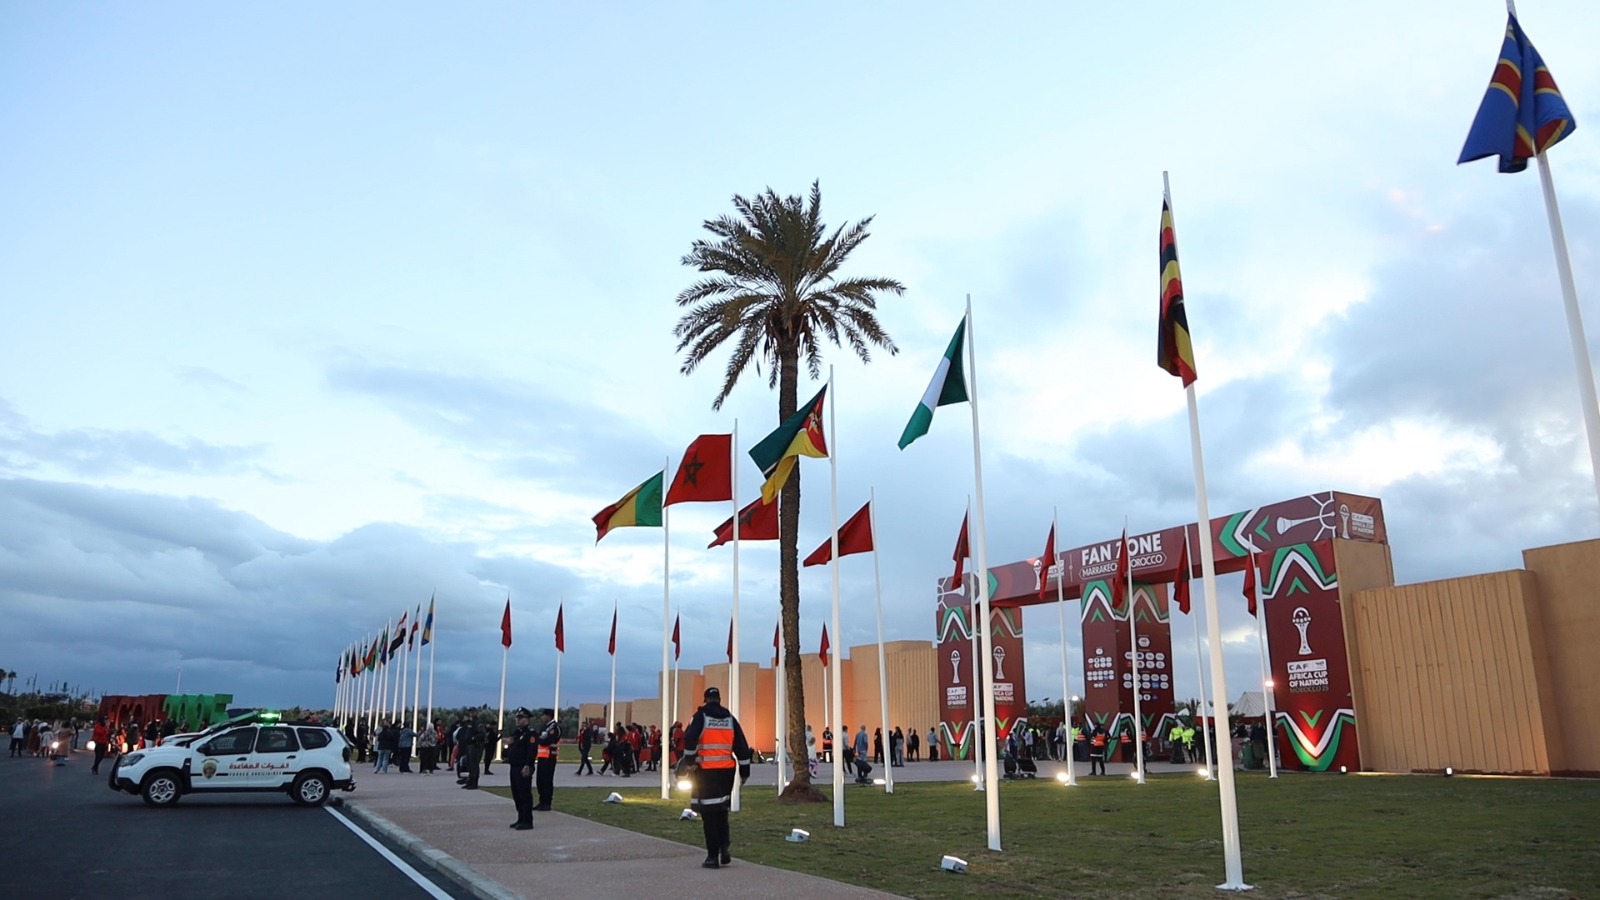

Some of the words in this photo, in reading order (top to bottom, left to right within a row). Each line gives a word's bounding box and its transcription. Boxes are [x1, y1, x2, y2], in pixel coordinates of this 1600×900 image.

[1082, 544, 1112, 566] FAN
[1082, 562, 1118, 577] MARRAKEC
[1130, 554, 1163, 568] OROCCO
[1289, 672, 1313, 680] AFRICA
[1289, 680, 1299, 688] OF
[1299, 678, 1329, 687] NATIONS
